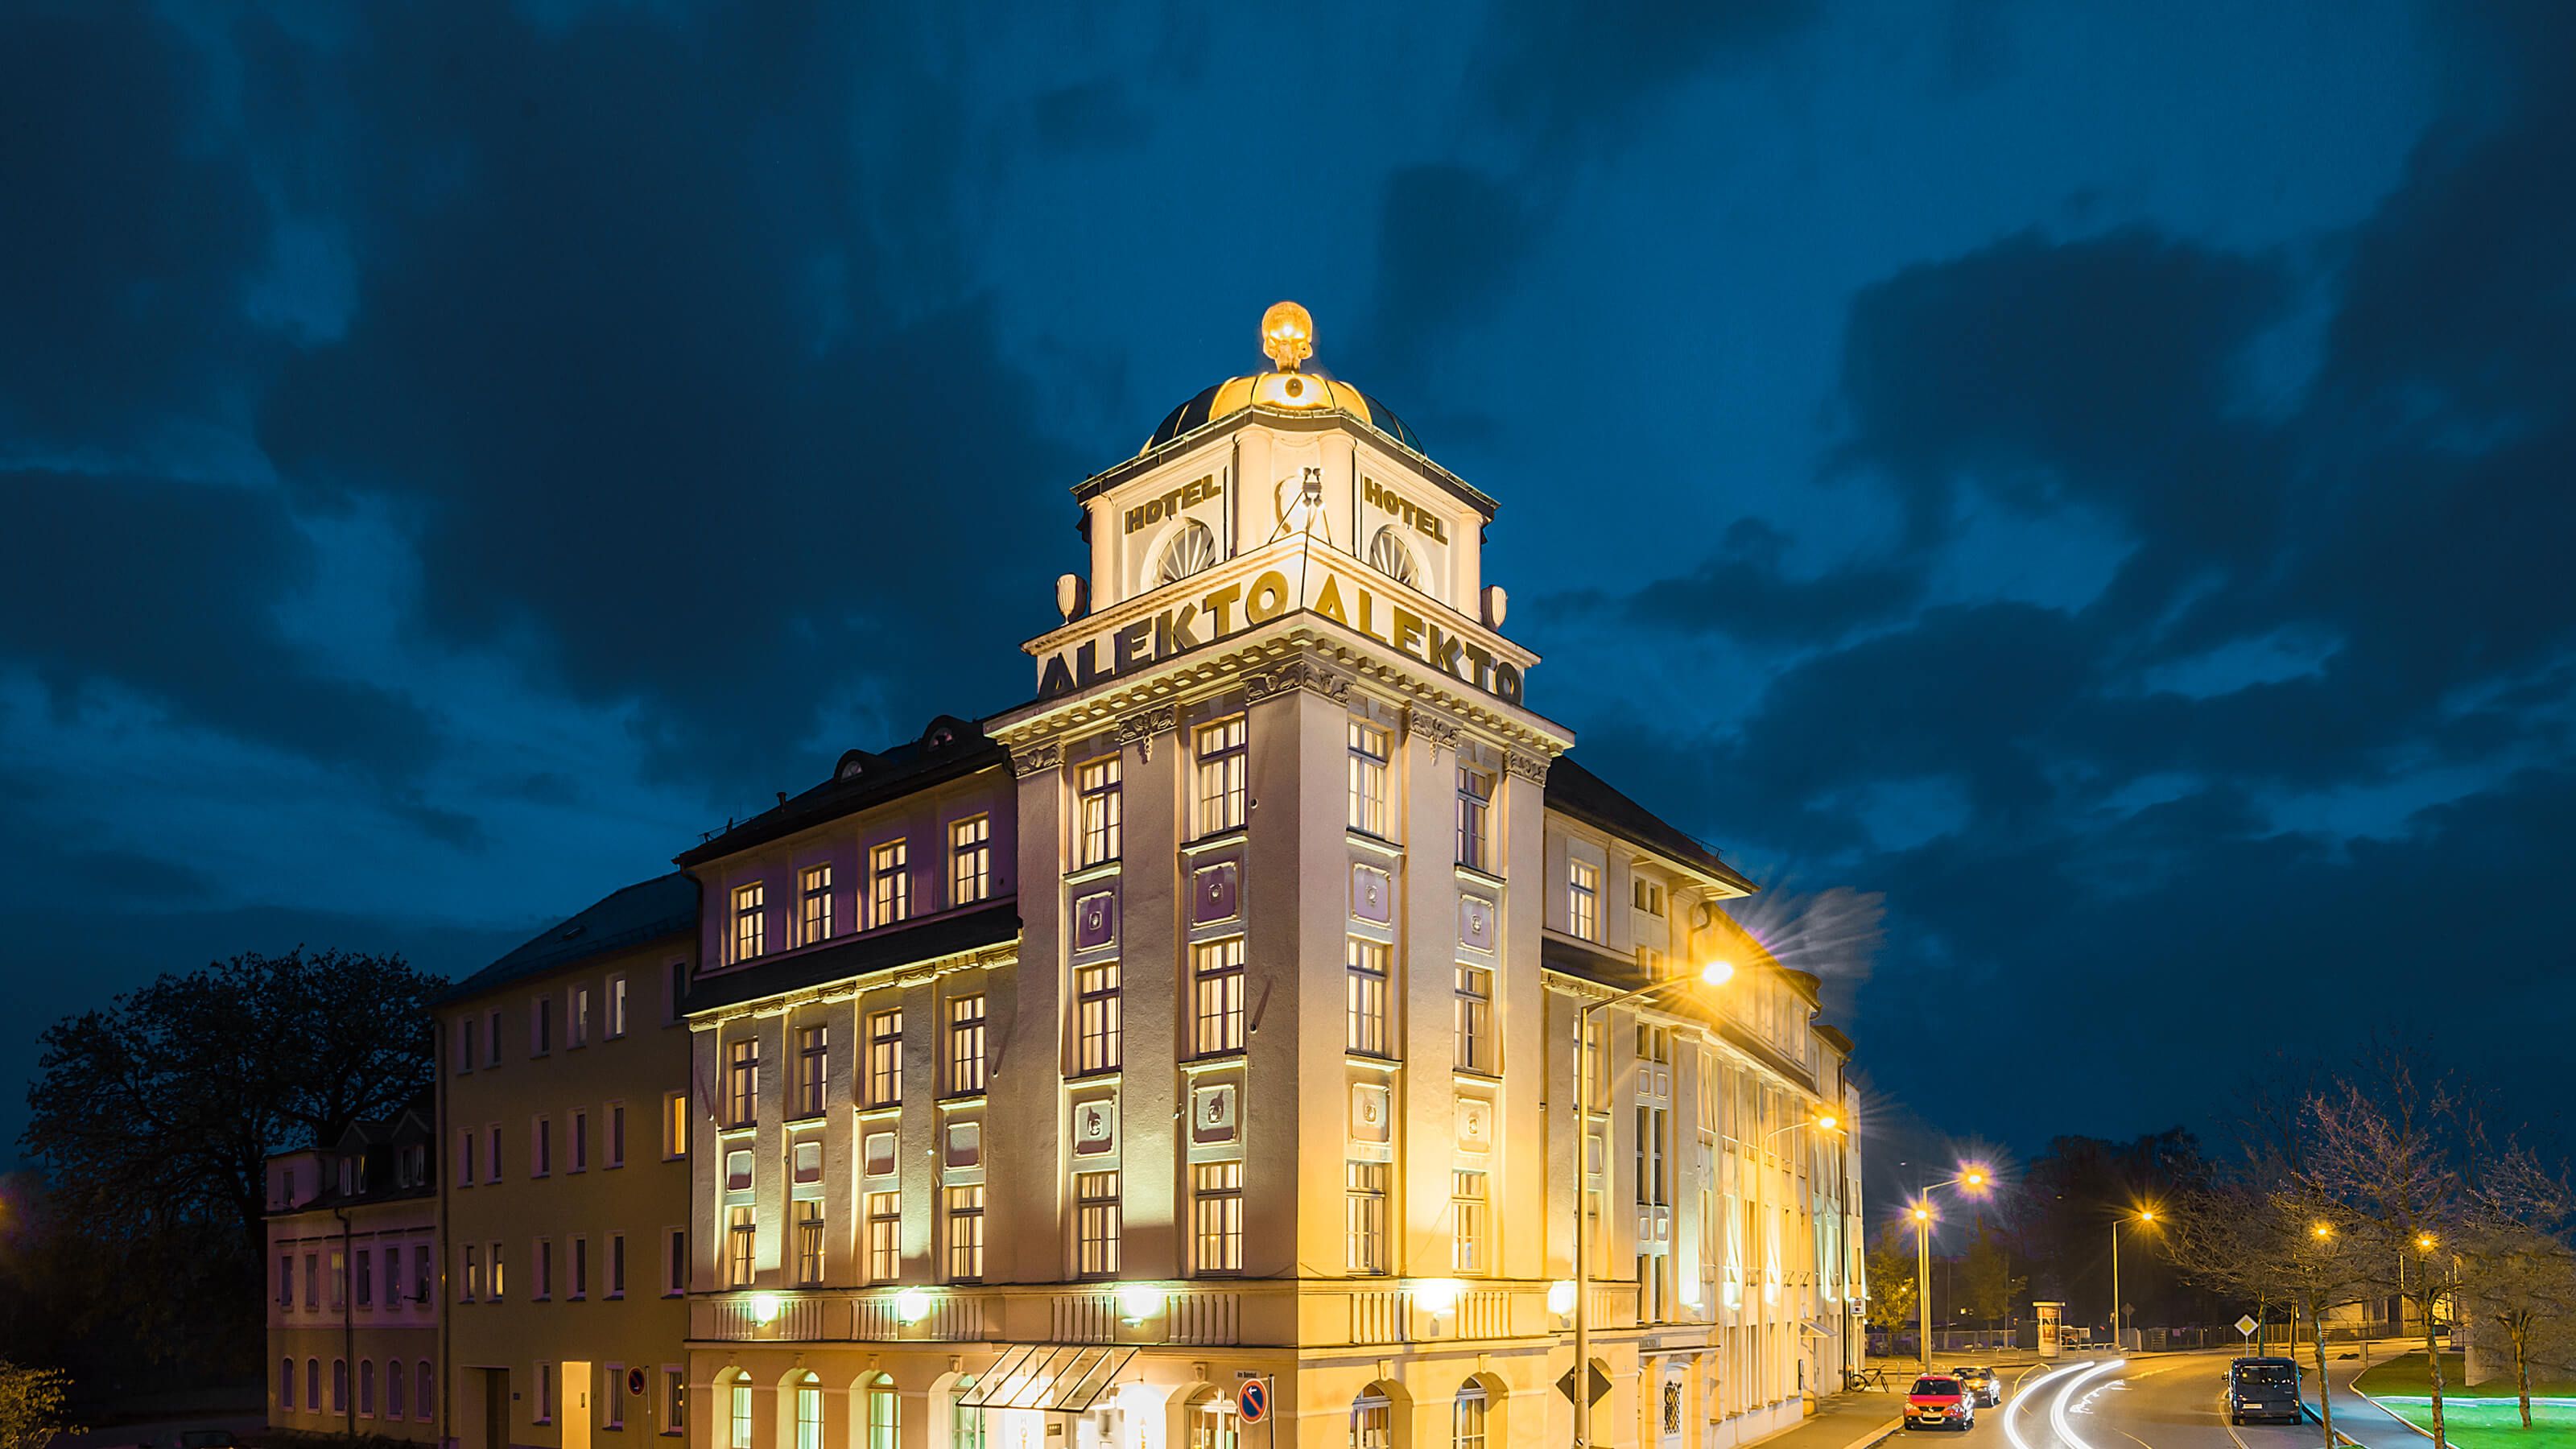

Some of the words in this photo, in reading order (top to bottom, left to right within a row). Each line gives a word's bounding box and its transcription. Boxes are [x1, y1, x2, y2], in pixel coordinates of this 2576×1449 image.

[1125, 474, 1222, 535] HOTEL
[1364, 477, 1448, 546] HOTEL
[1038, 570, 1289, 700] ALEKTO
[1314, 573, 1523, 706] ALEKTO
